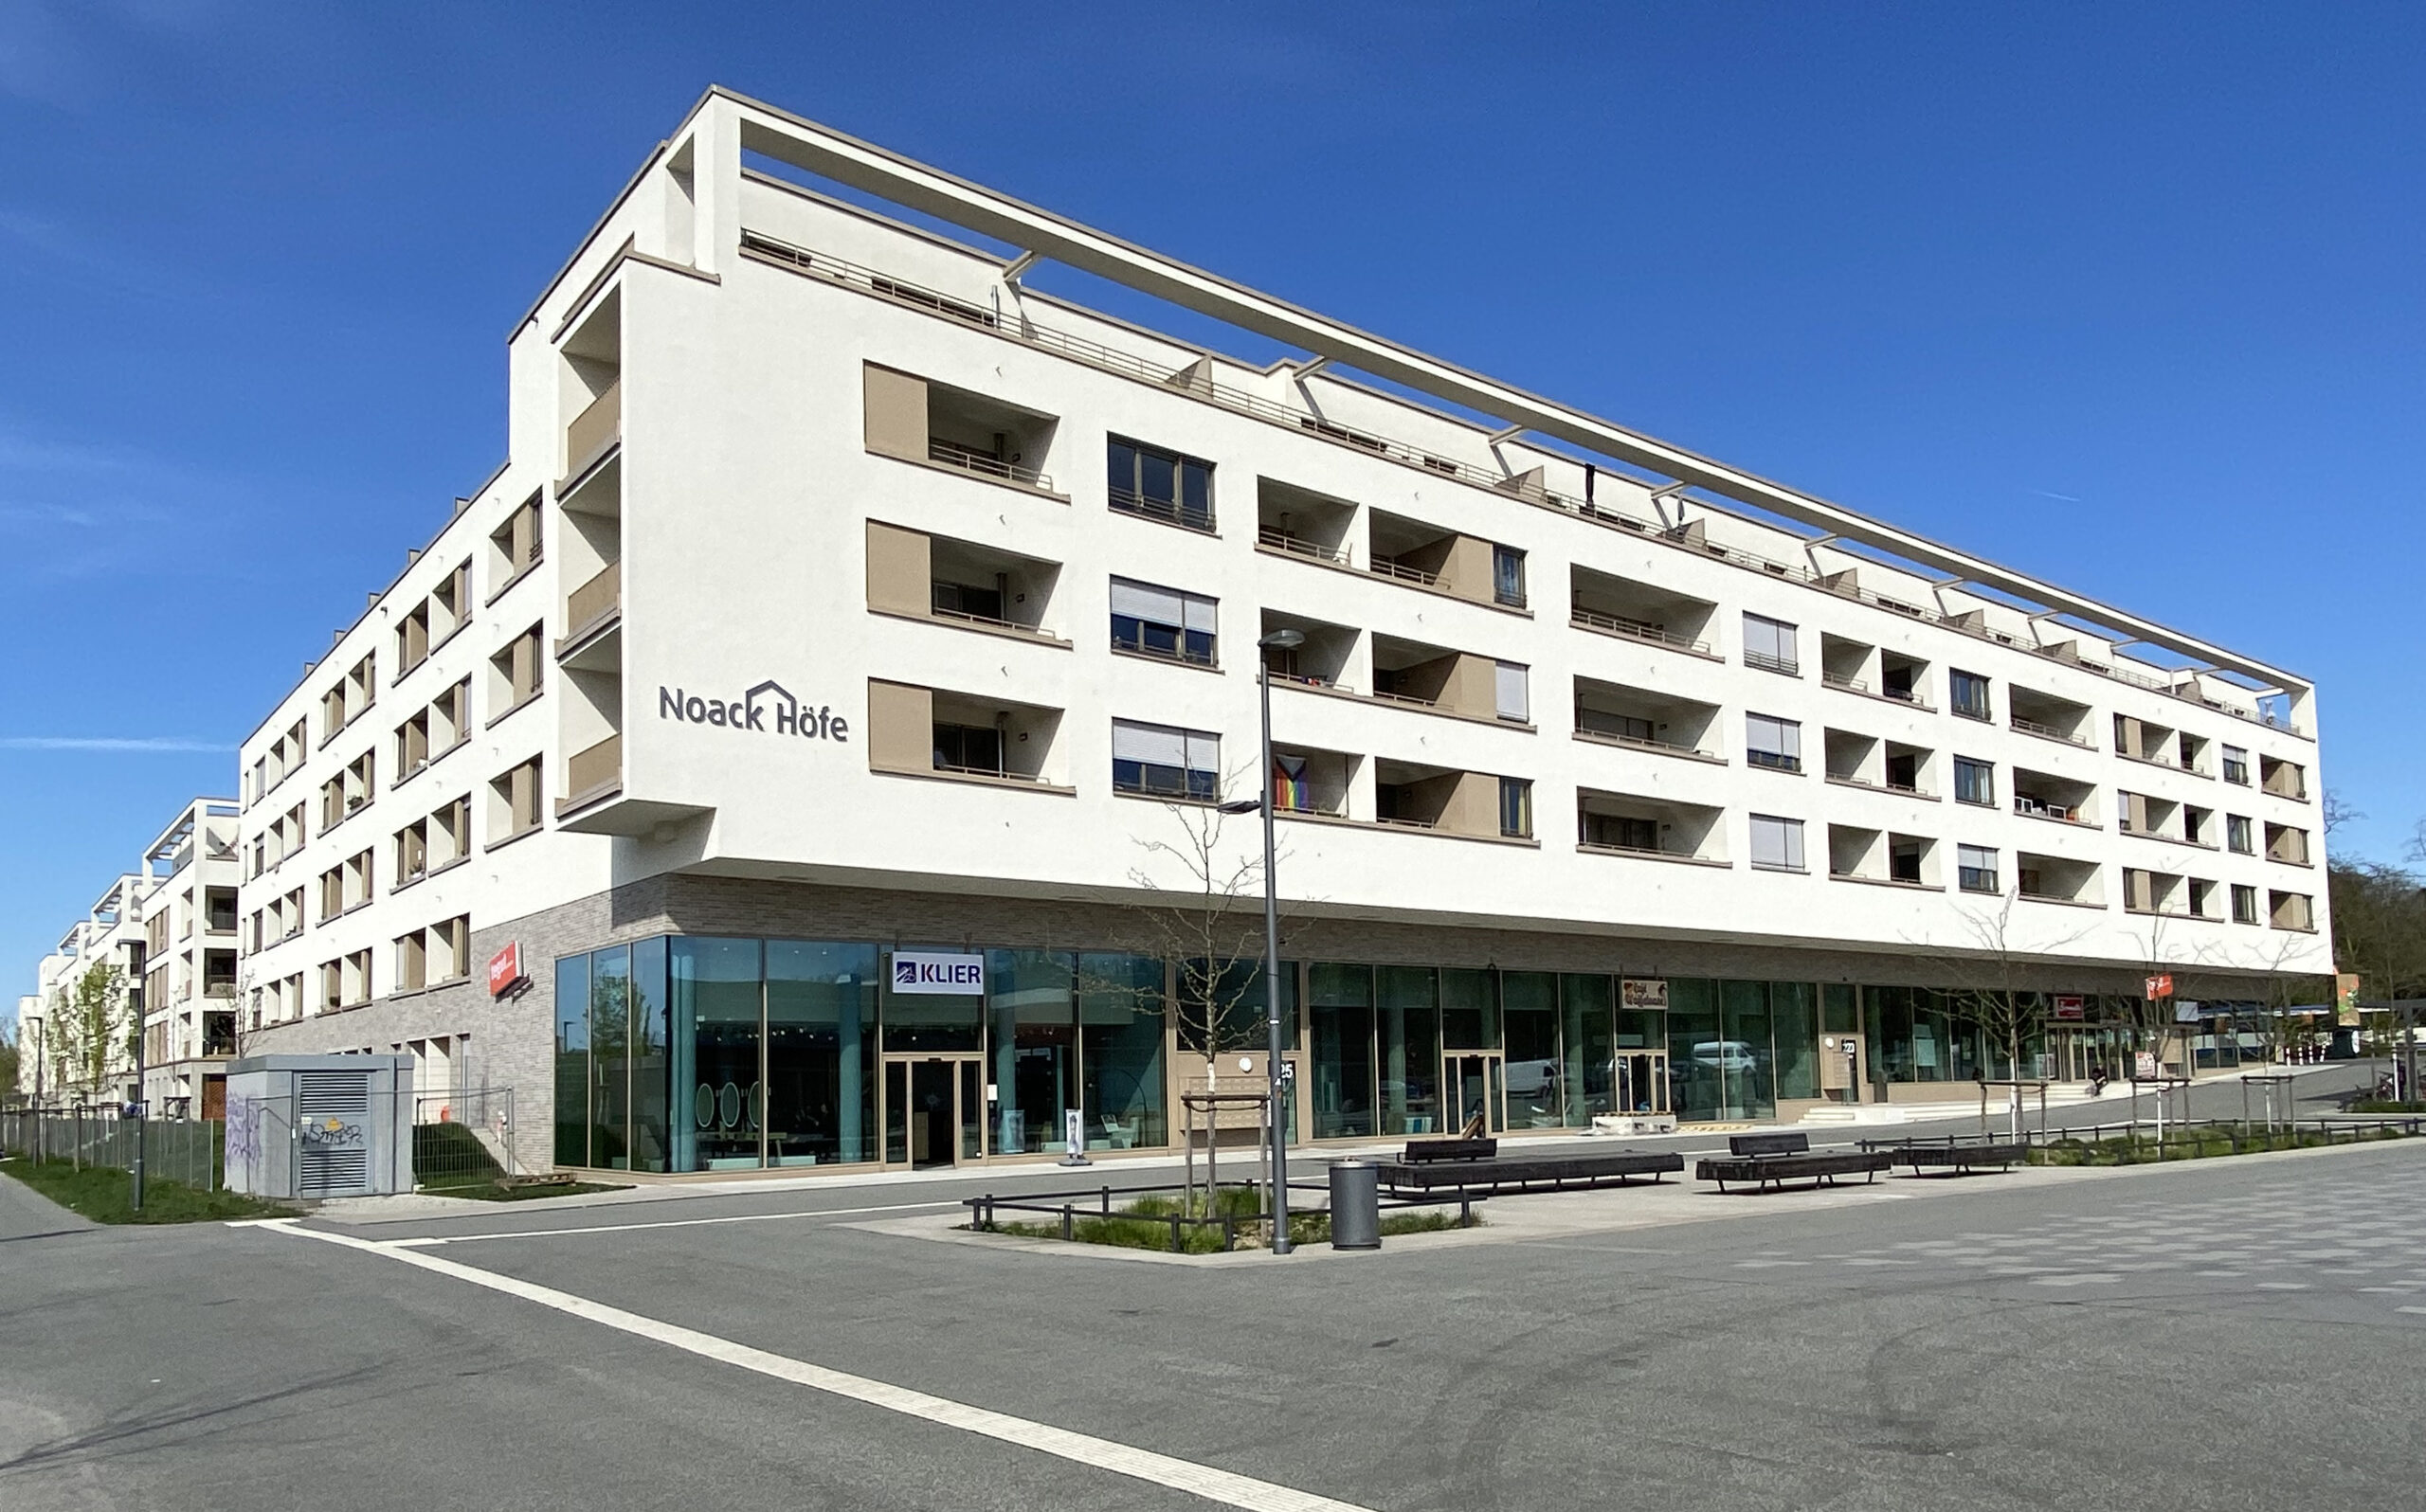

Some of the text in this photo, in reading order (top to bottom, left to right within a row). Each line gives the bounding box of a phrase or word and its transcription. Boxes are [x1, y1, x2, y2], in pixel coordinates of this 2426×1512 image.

[660, 685, 849, 743] Noack Höfe
[921, 963, 981, 984] KLIER
